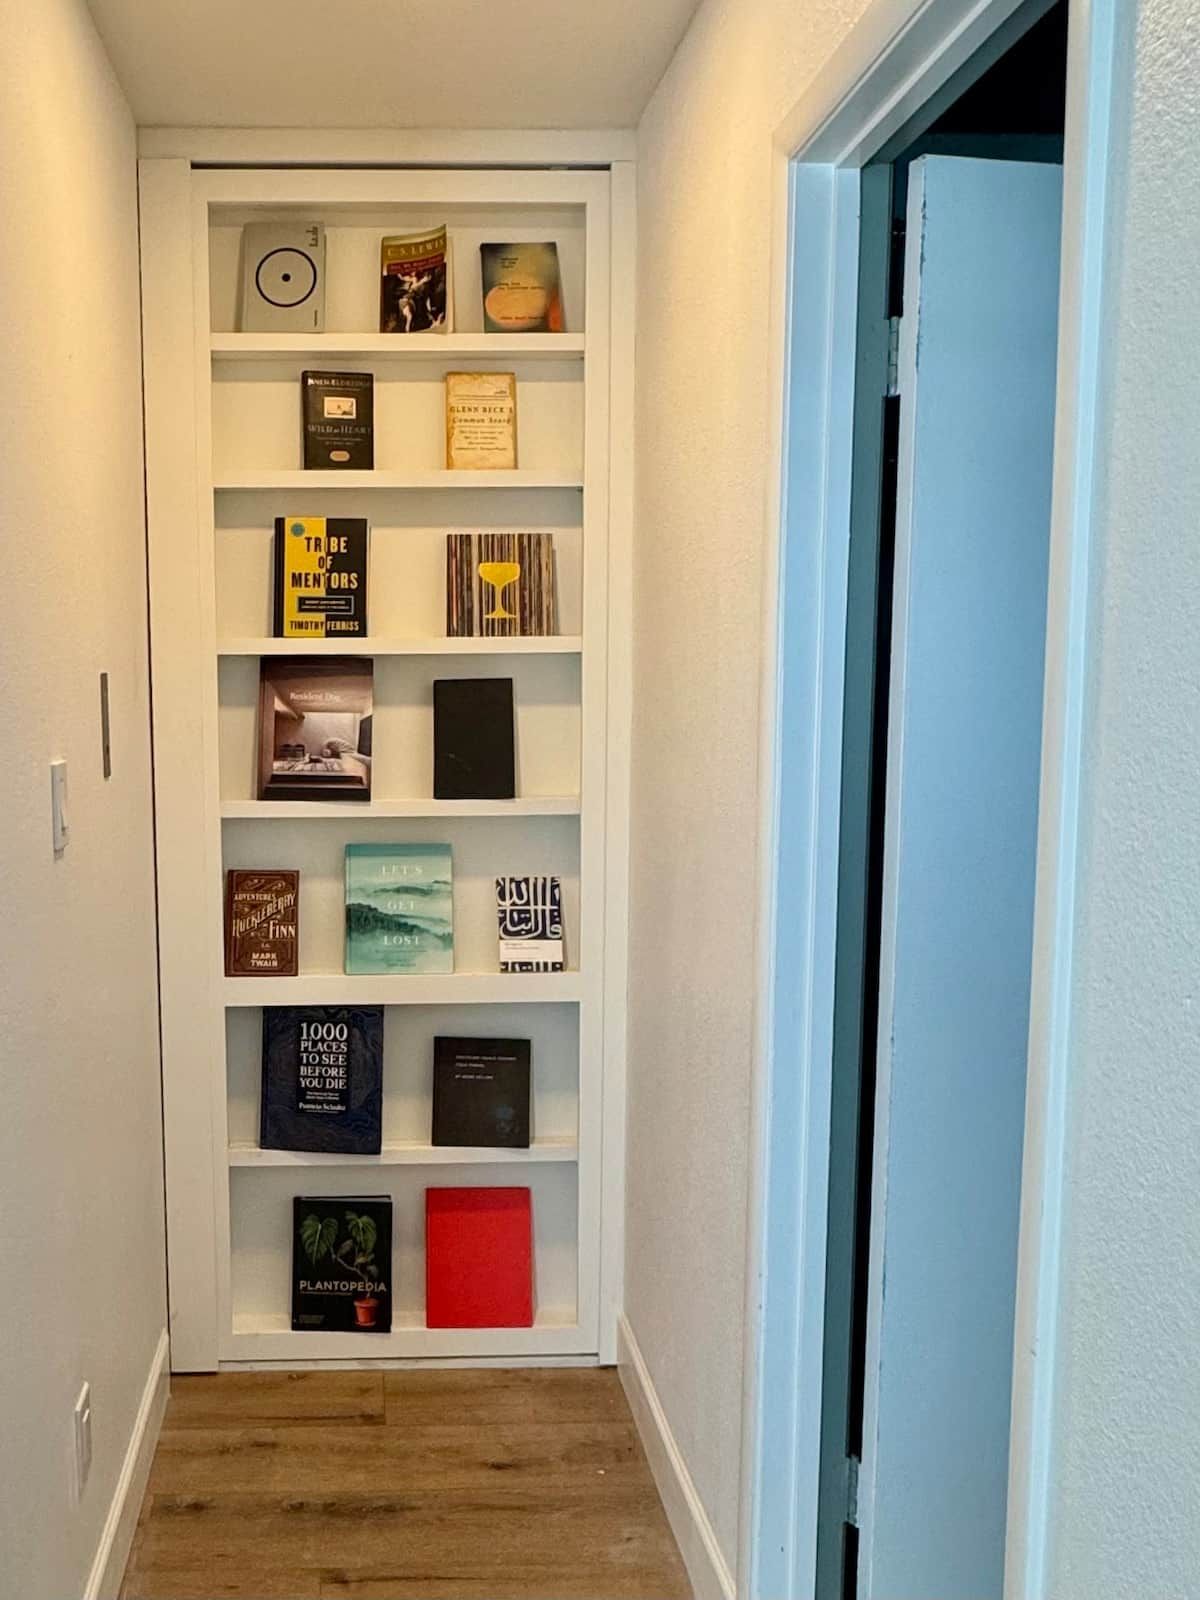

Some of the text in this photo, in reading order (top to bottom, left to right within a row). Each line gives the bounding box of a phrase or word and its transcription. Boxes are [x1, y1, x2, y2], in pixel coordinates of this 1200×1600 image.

[304, 536, 348, 553] TRIBE
[318, 556, 334, 569] OF
[291, 571, 358, 589] MENTORS
[290, 620, 360, 631] TIMOTHY FERRISS
[234, 893, 277, 901] ADVENTURES
[387, 900, 416, 911] GET
[232, 893, 296, 937] HUCKLEBERRY
[269, 919, 296, 940] FINN
[383, 935, 420, 946] LOST
[252, 952, 277, 960] MARK
[250, 959, 278, 967] TWAIN
[300, 1041, 348, 1053] PLACES
[300, 1053, 347, 1066] TO SEE
[300, 1066, 347, 1078] BEFORE
[300, 1077, 347, 1089] YOU DIE
[299, 1280, 386, 1292] PLANTOPEDIA
